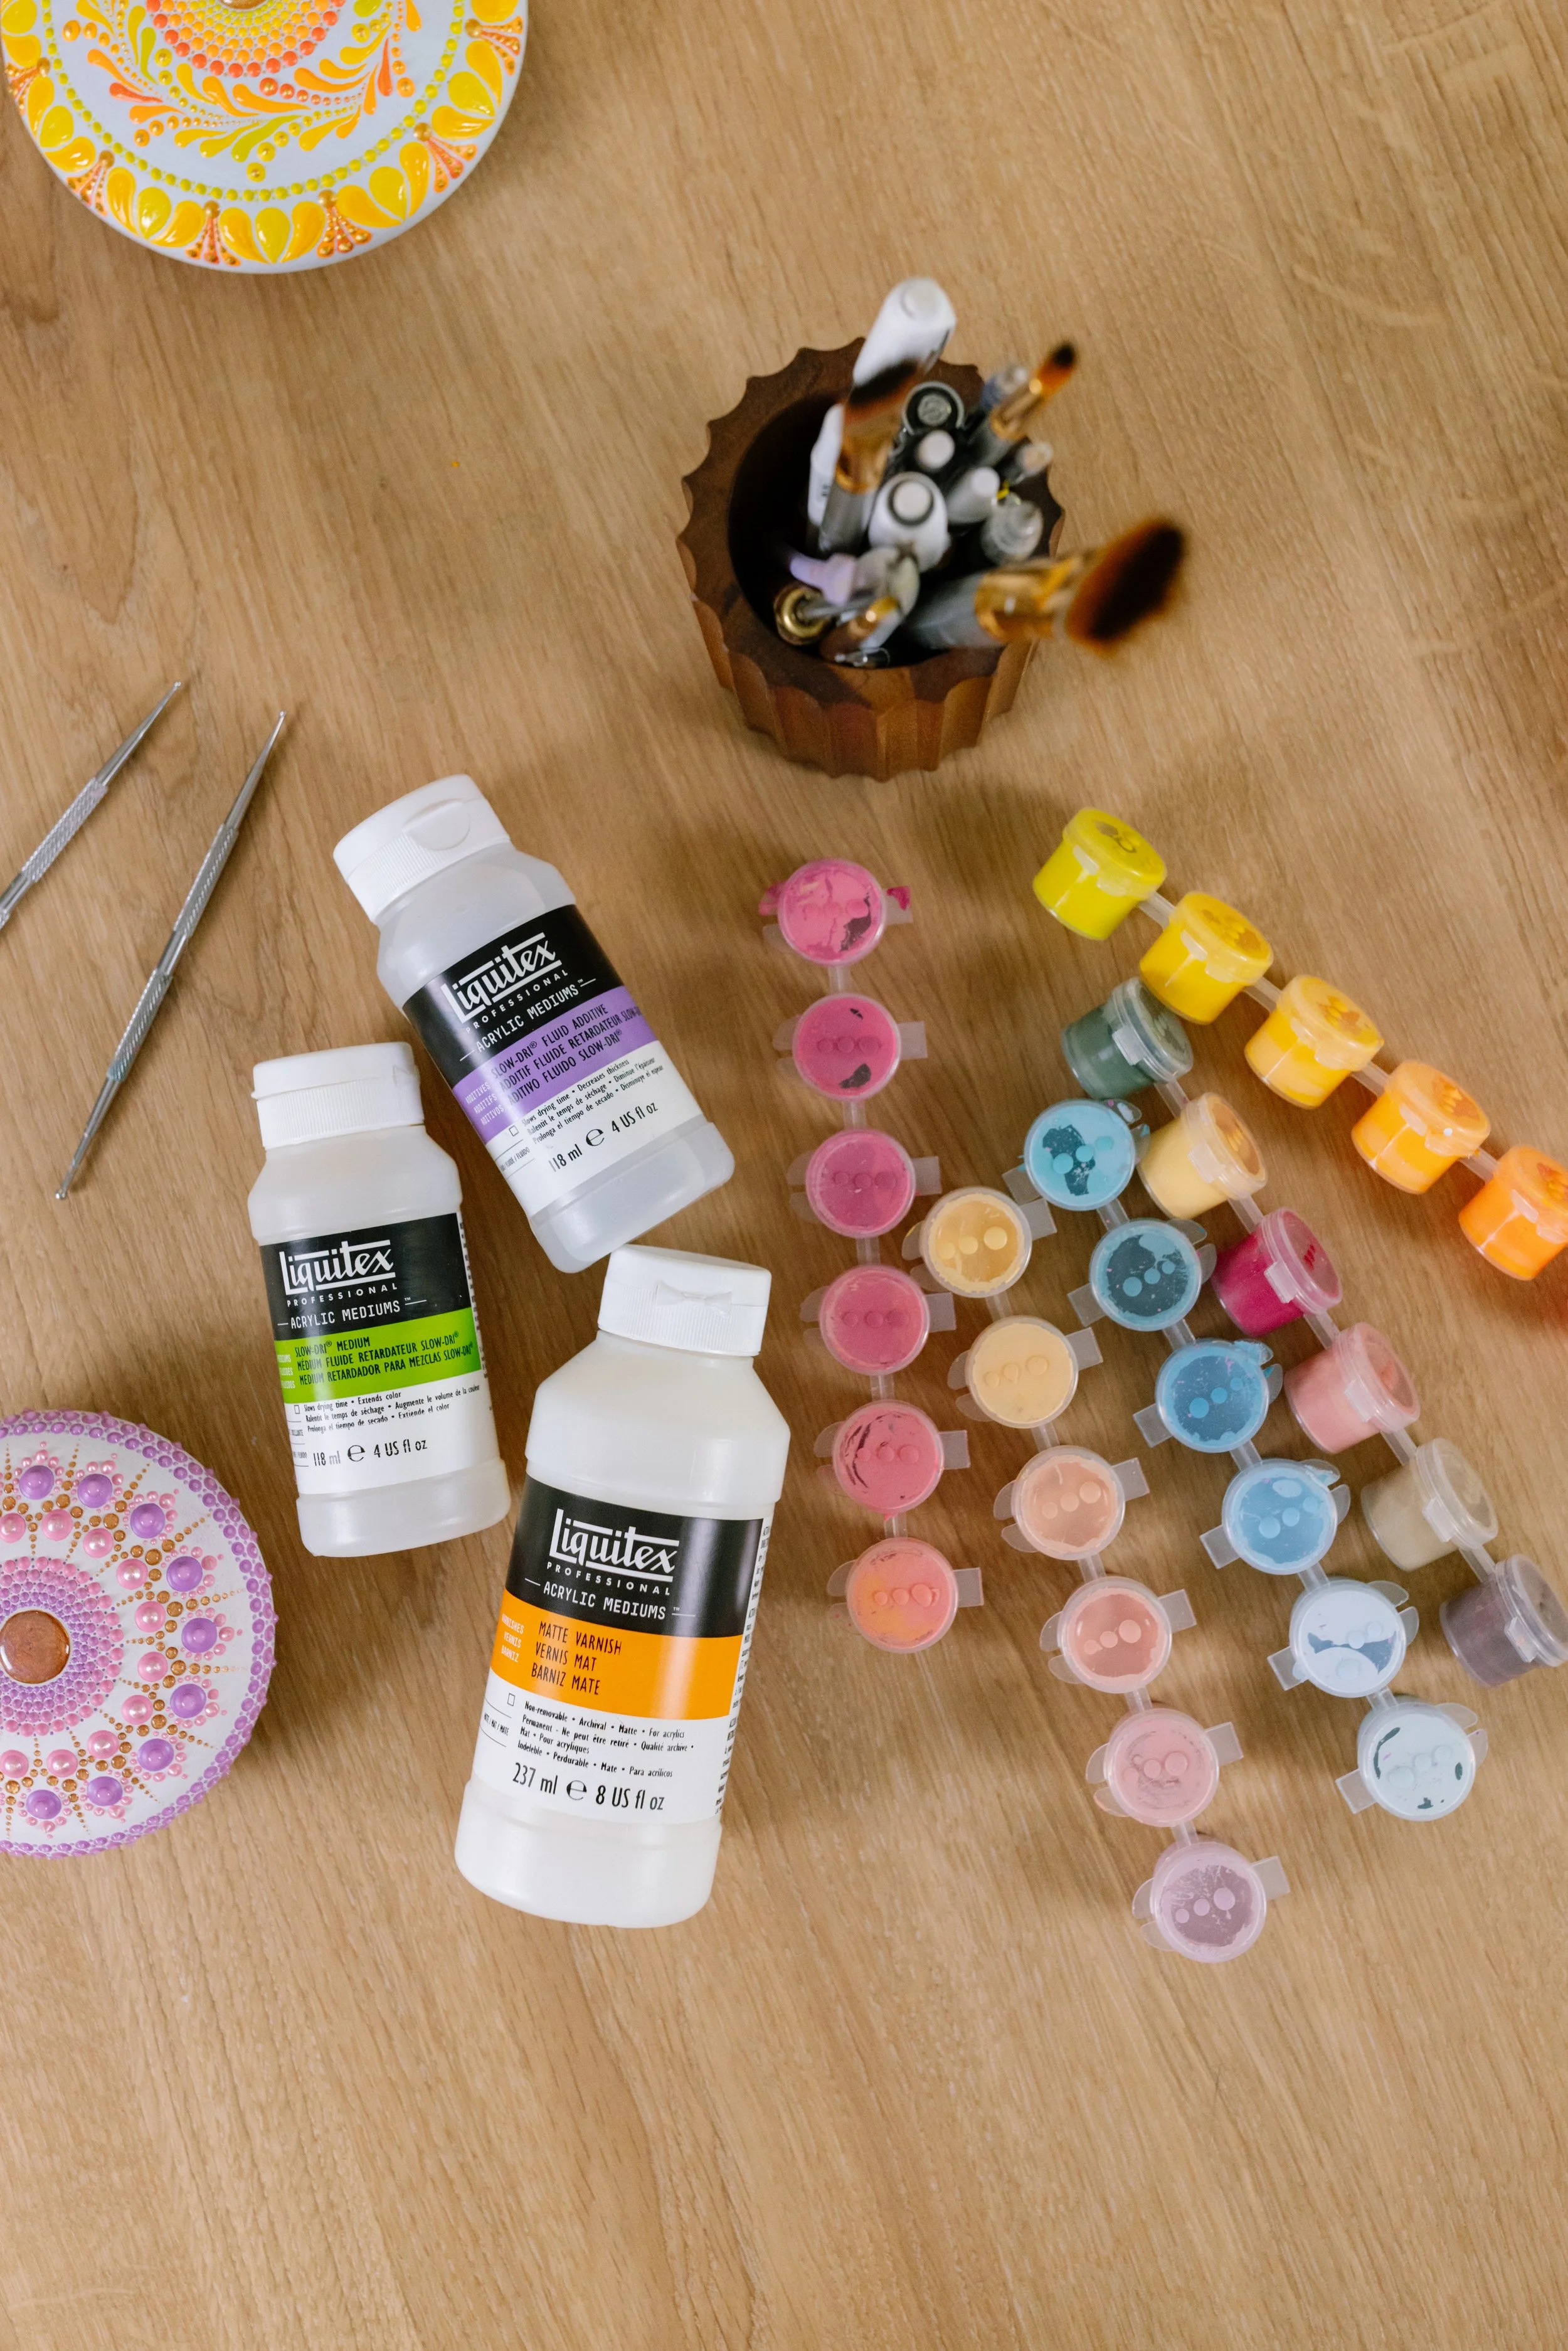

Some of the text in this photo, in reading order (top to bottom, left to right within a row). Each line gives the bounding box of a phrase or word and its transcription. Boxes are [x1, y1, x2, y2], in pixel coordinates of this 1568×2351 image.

[440, 932, 562, 1024] Liquitex
[466, 969, 568, 1034] PROFESSIONAL
[476, 1015, 524, 1053] ACRYLIC
[541, 1025, 569, 1047] FLUID
[572, 1004, 608, 1030] ADDITIVE
[501, 1064, 532, 1092] ADDITIF
[533, 1044, 567, 1069] FLUIDE
[568, 1014, 622, 1049] RETARDATEUR
[465, 1081, 490, 1104] ADDITIVES
[509, 1078, 540, 1105] ADITIVO
[542, 1056, 576, 1083] FLUIDO
[522, 1059, 629, 1127] Slows drying time Decreases thickness
[474, 1093, 497, 1115] ADDITIFS
[480, 1104, 504, 1125] ADITIVOS
[527, 1119, 548, 1135] Ralentit
[556, 1104, 574, 1117] temps
[585, 1084, 607, 1100] séchage
[613, 1068, 635, 1082] Diminue
[532, 1128, 556, 1144] Prolonga
[564, 1110, 584, 1125] tiempo
[595, 1091, 614, 1106] secado
[620, 1075, 645, 1091] Disminuye
[548, 1154, 566, 1172] 118
[568, 1144, 583, 1161] ml
[612, 1120, 620, 1133] 4
[620, 1111, 636, 1127] US
[635, 1106, 645, 1119] fl
[646, 1103, 659, 1114] oz
[279, 1239, 396, 1295] Liquitex
[287, 1283, 397, 1307] PROFESSIONAL
[291, 1312, 336, 1329] ACRYLIC
[297, 1359, 322, 1371] MÉDIUM
[326, 1354, 354, 1367] FLUIDE
[358, 1342, 418, 1362] RETARDATEUR
[336, 1336, 371, 1351] MEDIUM
[299, 1372, 324, 1386] MEDIUM
[327, 1365, 381, 1382] RETARDADOR
[384, 1359, 406, 1372] PARA
[409, 1352, 442, 1367] MEZCLAS
[304, 1404, 315, 1412] Slows
[317, 1403, 333, 1411] drying
[358, 1394, 382, 1404] Extends
[386, 1391, 401, 1400] color
[305, 1413, 322, 1422] Ralentit
[324, 1413, 329, 1421] le
[331, 1412, 348, 1420] temps
[361, 1406, 384, 1415] séchage
[395, 1399, 424, 1409] Augmente
[435, 1392, 453, 1401] volume
[307, 1425, 326, 1433] Prolonga
[336, 1422, 355, 1431] tiempo
[368, 1415, 388, 1425] secado
[398, 1408, 425, 1419] Extiende
[436, 1403, 450, 1411] color
[314, 1452, 326, 1466] 118
[329, 1450, 341, 1465] ml
[374, 1444, 381, 1458] 4
[384, 1441, 399, 1457] US
[403, 1439, 411, 1453] fl
[415, 1440, 428, 1451] oz
[549, 1508, 679, 1583] Liquitex
[543, 1581, 596, 1608] ACRYLIC
[547, 1561, 670, 1596] PROFESSIONAL
[501, 1645, 519, 1662] BARNIZ
[504, 1631, 522, 1648] VERNIS
[538, 1621, 622, 1655] MATTE VARNISH
[536, 1642, 597, 1672] VERNIS MAT
[531, 1662, 600, 1695] BARNIZ MATE
[499, 1724, 509, 1736] MATE
[522, 1714, 687, 1752] Permanent Ne peut être retiré Qualité archive
[524, 1701, 685, 1740] Non-removable Archival Matte For acrylics
[521, 1726, 590, 1754] Mat Pour acryliques
[518, 1740, 673, 1777] Indeleble Perdurable Mate Para acrílicos
[512, 1762, 536, 1788] 237
[540, 1775, 558, 1795] ml
[595, 1785, 606, 1805] 8
[612, 1786, 630, 1808] US
[635, 1789, 645, 1809] fl
[650, 1796, 665, 1810] oz
